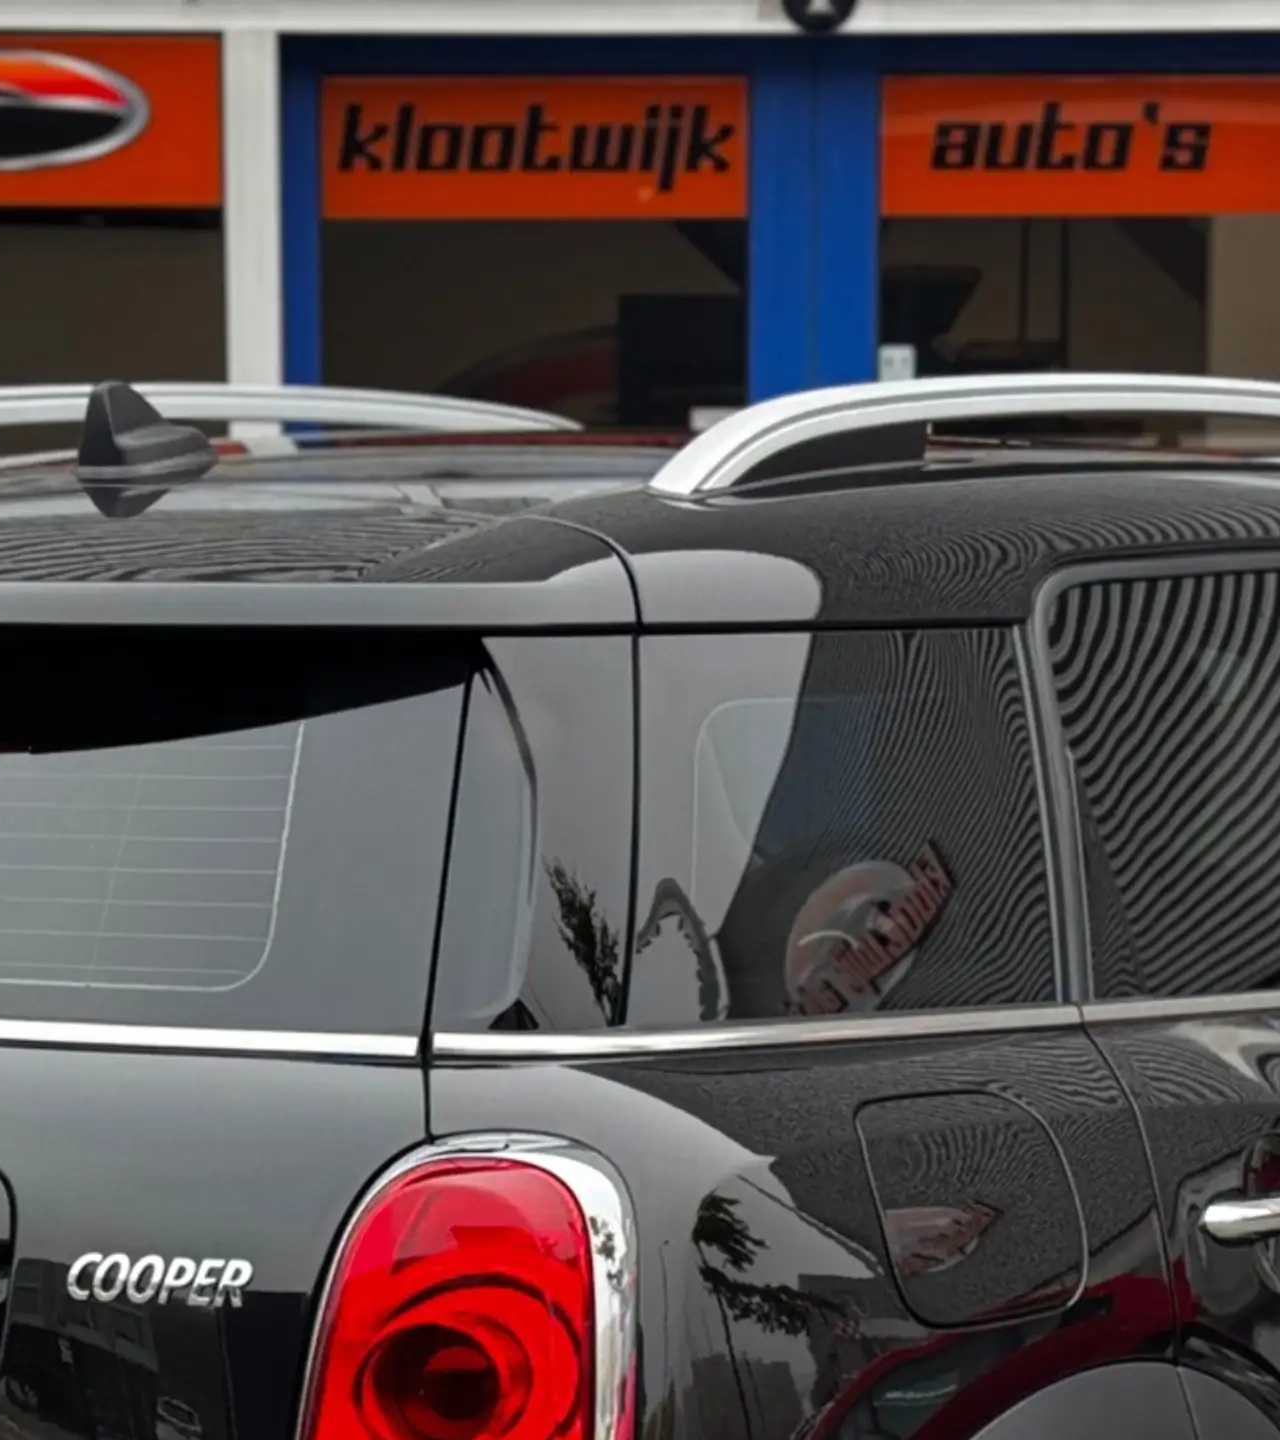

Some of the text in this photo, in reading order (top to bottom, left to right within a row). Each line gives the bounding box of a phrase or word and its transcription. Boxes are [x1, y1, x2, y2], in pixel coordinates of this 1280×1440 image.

[337, 100, 1212, 194] klootwijk auto's
[66, 1252, 254, 1308] COOPER
